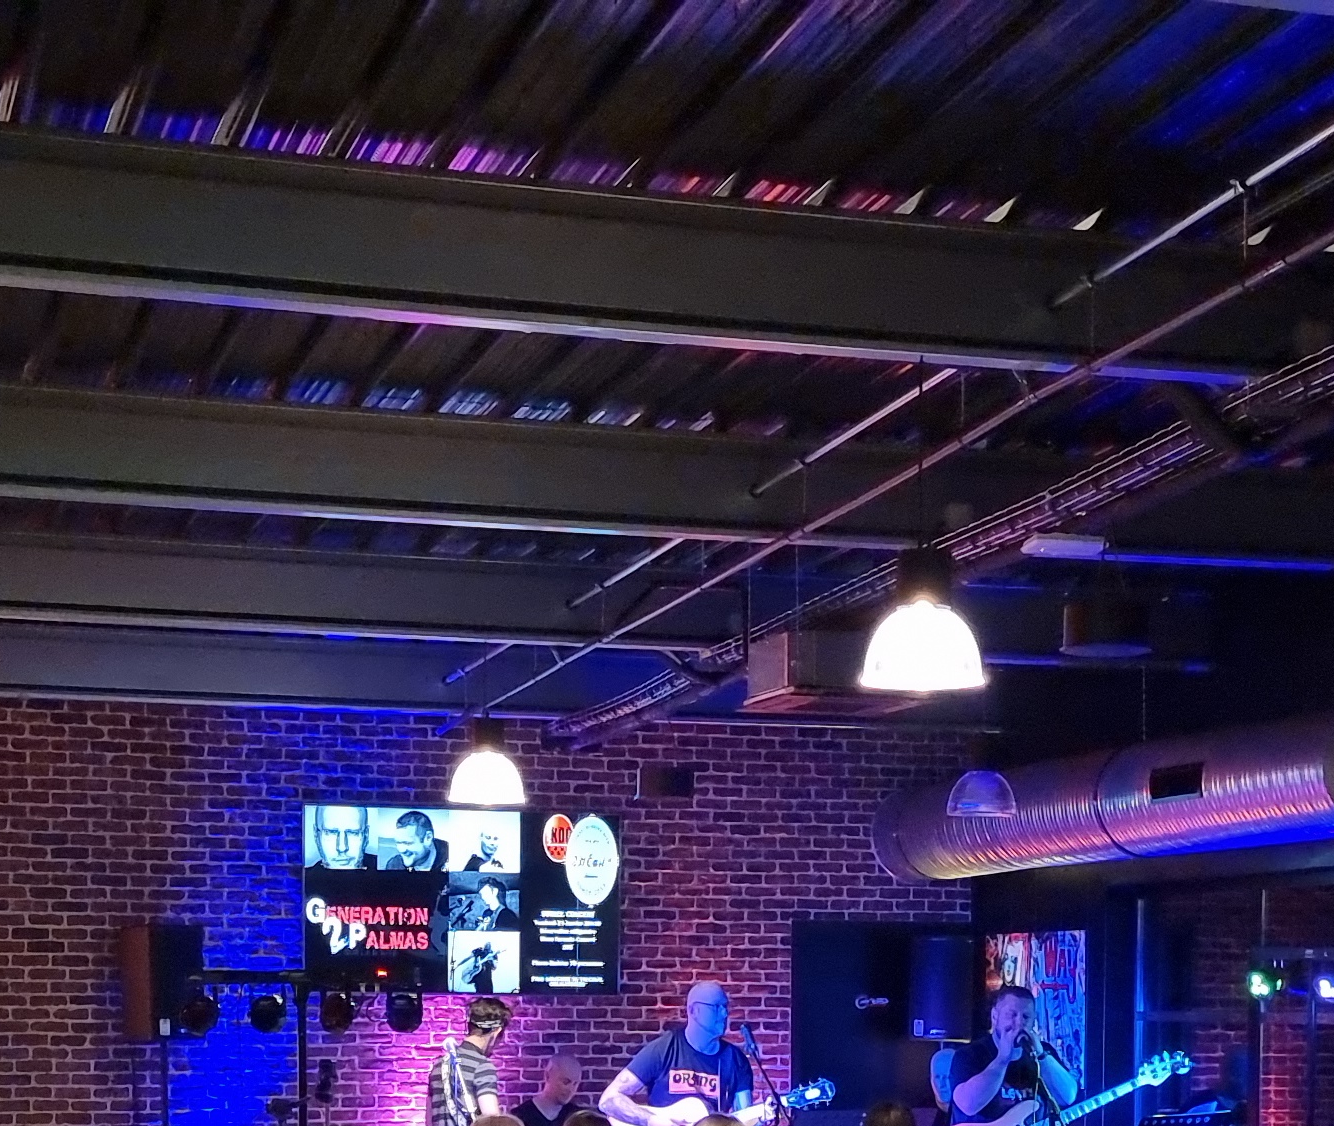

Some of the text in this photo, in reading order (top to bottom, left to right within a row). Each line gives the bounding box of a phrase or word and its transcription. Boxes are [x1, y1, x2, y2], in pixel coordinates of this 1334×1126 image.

[305, 897, 429, 926] GENERATION
[321, 916, 429, 954] 2 PALMAS
